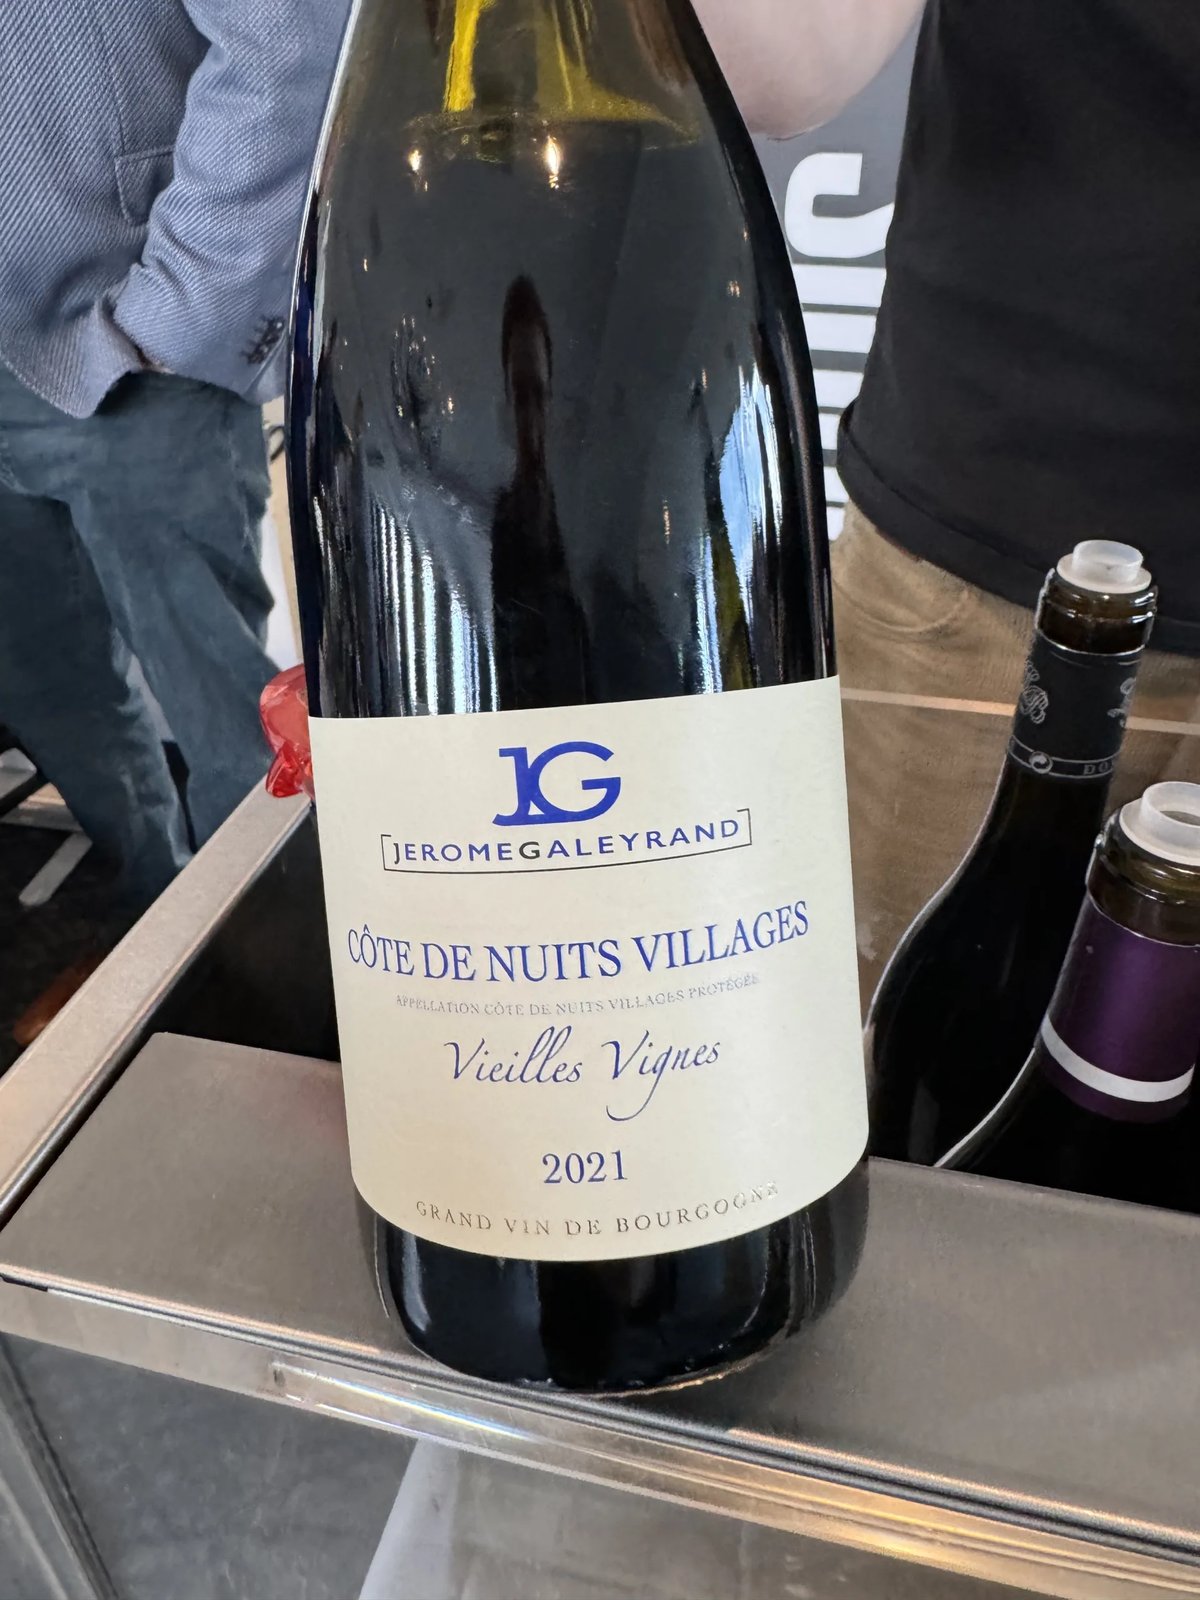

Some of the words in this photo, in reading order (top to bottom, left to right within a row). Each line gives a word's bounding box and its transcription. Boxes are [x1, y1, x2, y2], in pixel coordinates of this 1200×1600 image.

[348, 924, 416, 976] CÔTE
[420, 942, 477, 982] DE
[483, 939, 622, 983] NUITS
[631, 900, 811, 972] VILLAGES
[396, 994, 480, 1015] APPELLATION
[484, 1000, 525, 1017] CÔTE
[529, 1003, 551, 1016] DE
[555, 1001, 605, 1016] NUITS
[609, 989, 686, 1011] VILLAGES
[443, 1025, 583, 1084] Vieilles
[601, 1030, 721, 1122] Vignes
[541, 1150, 629, 1185] 2021
[416, 1200, 492, 1231] GRAND
[503, 1219, 550, 1236] VIN
[563, 1219, 601, 1237] DE
[616, 1181, 780, 1234] BOURGOGNE
